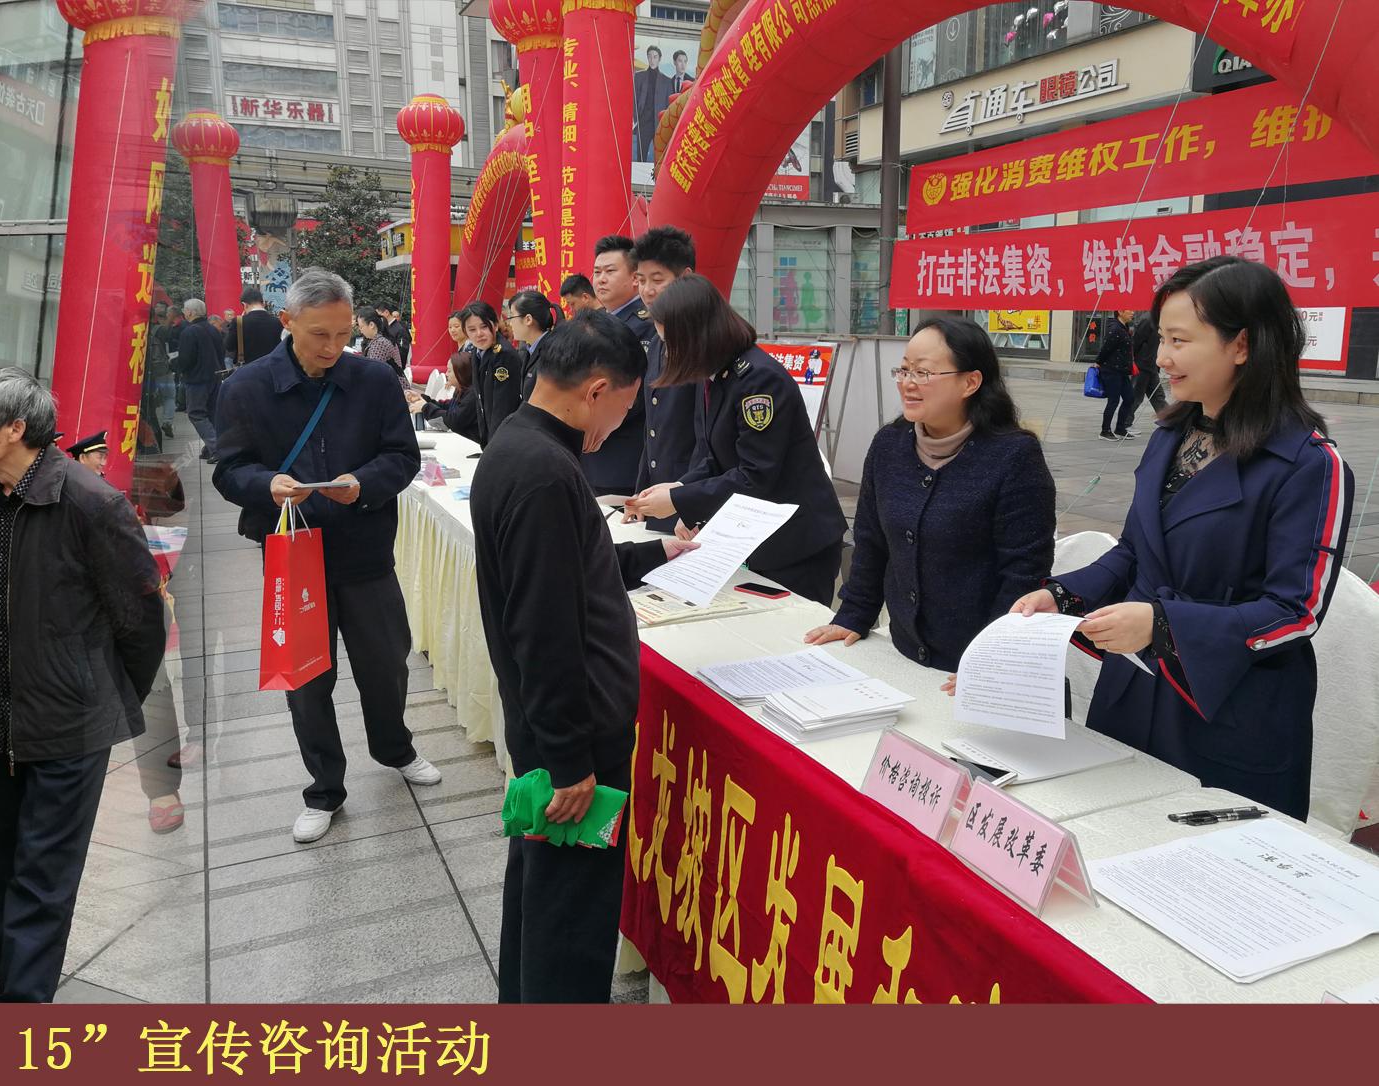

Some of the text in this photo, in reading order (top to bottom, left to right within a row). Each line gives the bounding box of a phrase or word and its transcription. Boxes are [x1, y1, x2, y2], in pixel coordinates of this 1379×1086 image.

[240, 95, 325, 122] 新华乐器
[940, 58, 1121, 135] 直通车眼镜公司
[917, 222, 1379, 297] 打击非法集资，维护金融稳定，
[878, 755, 942, 813] 价格咨询投诉
[629, 709, 1000, 1003] 龙坡区发展
[965, 802, 1047, 877] 区发展改革委
